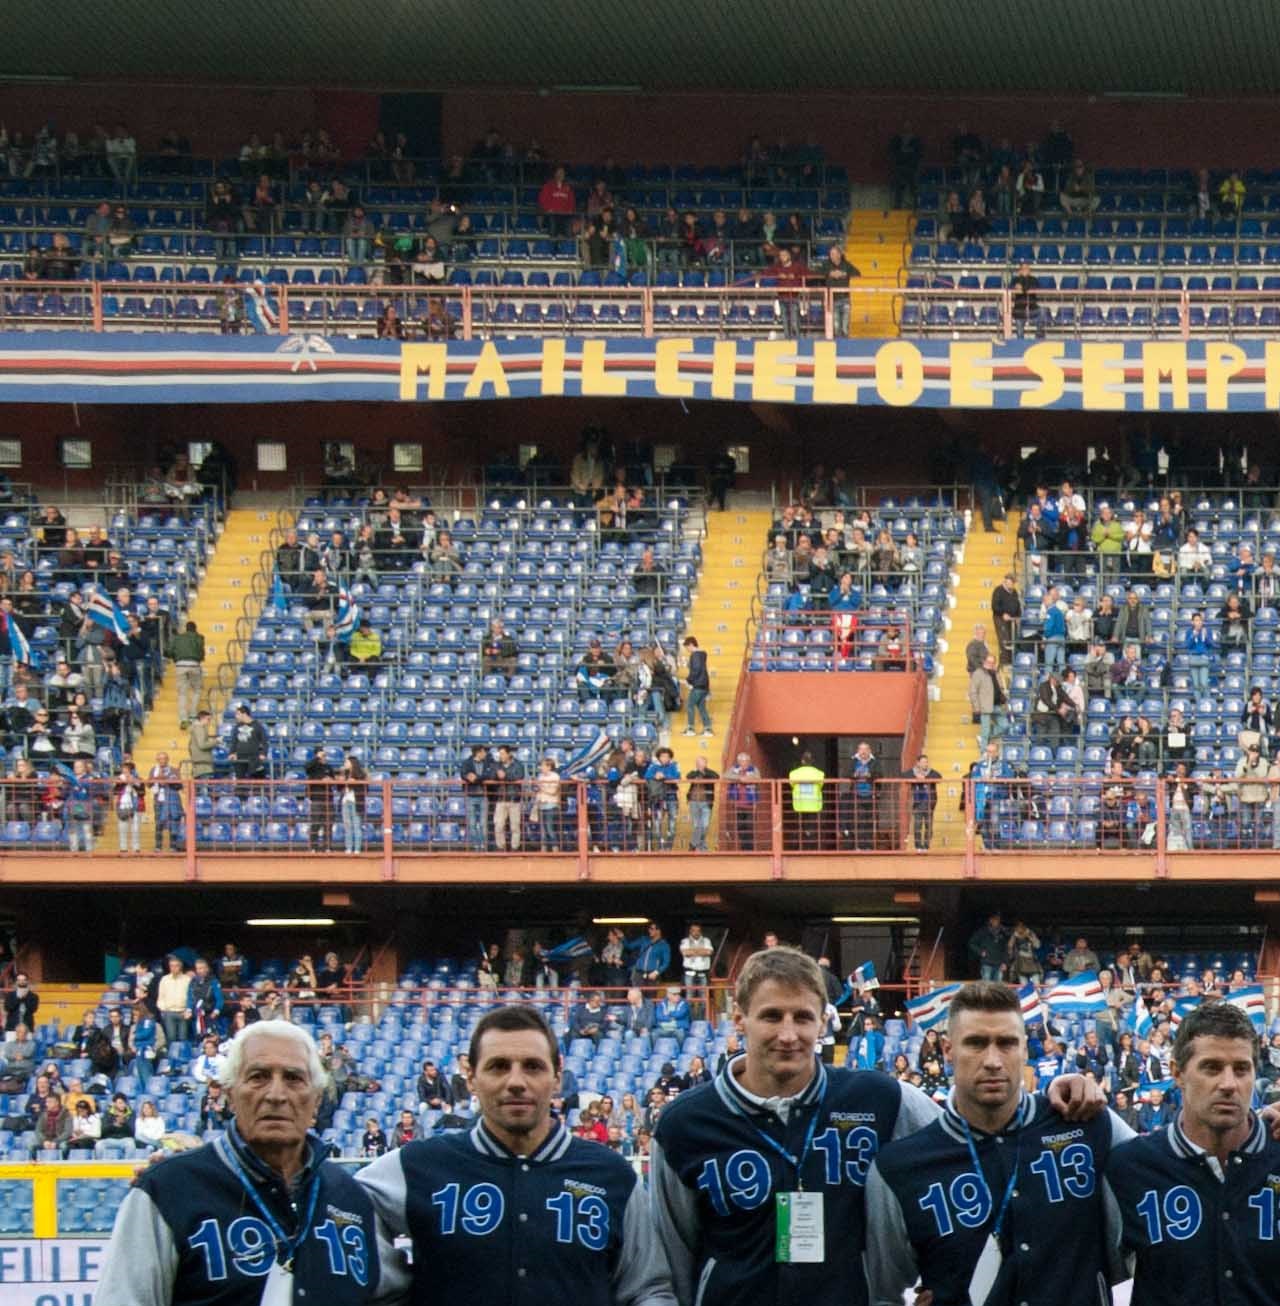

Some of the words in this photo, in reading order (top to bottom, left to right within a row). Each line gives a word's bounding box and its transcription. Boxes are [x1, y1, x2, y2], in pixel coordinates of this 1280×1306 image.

[399, 340, 511, 399] MA
[541, 339, 628, 398] IL
[654, 339, 923, 407] CIELO
[697, 1149, 771, 1217] 19
[813, 1125, 878, 1186] 13
[919, 1172, 992, 1236] 19
[1031, 1143, 1096, 1203] 13
[431, 1182, 504, 1236] 19
[546, 1191, 610, 1251] 13
[1137, 1184, 1202, 1244] 19
[189, 1216, 276, 1281] 19
[314, 1219, 369, 1286] 13
